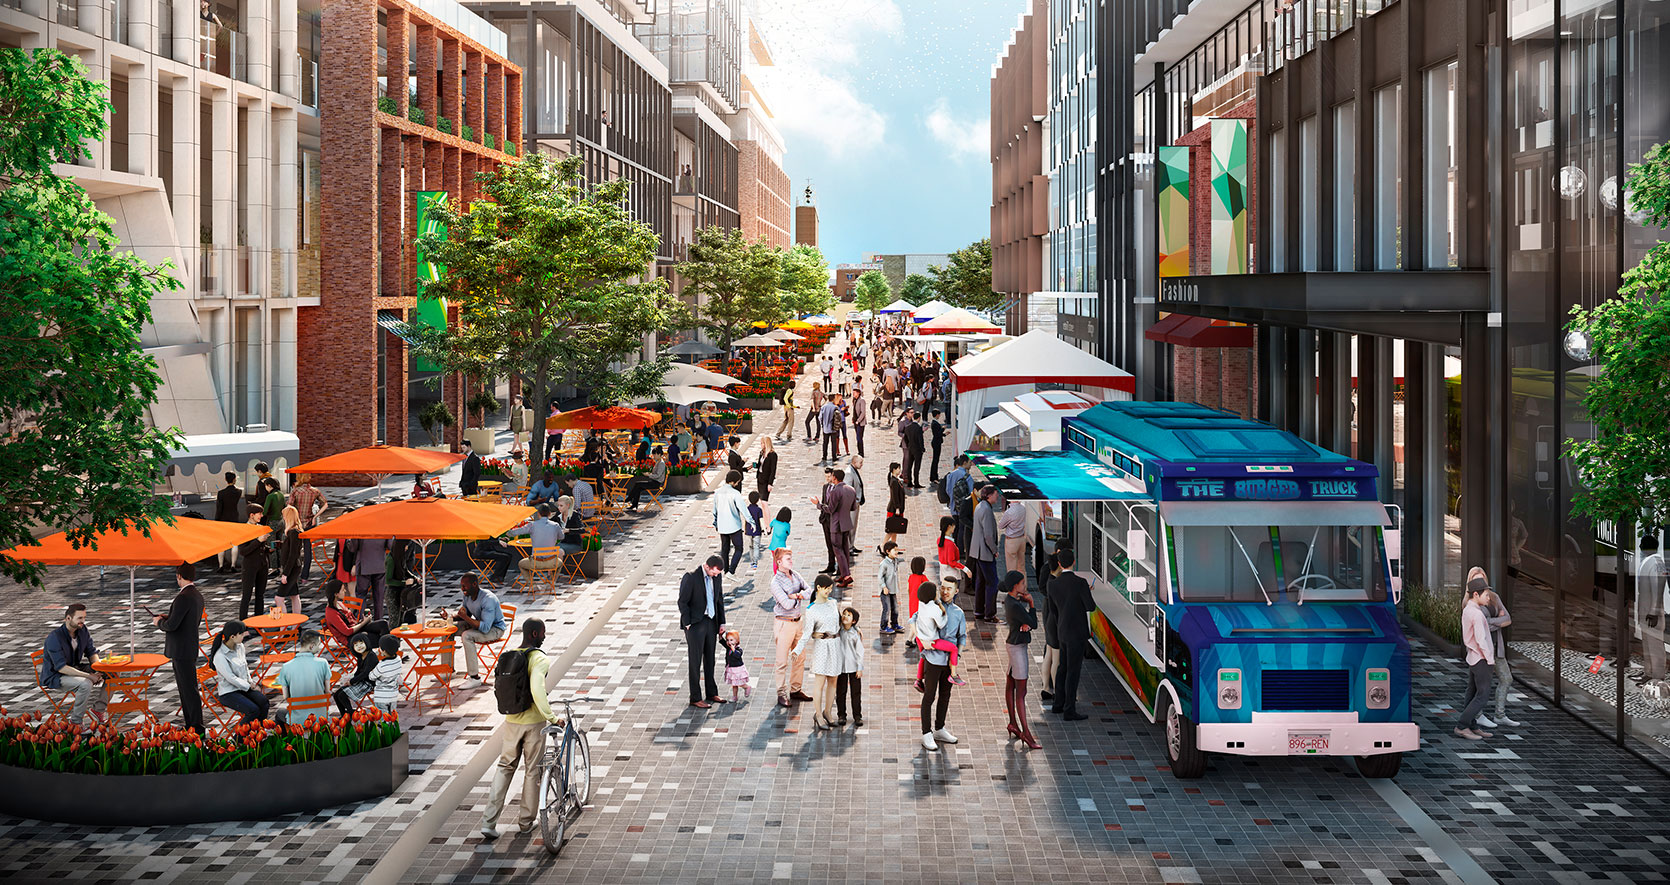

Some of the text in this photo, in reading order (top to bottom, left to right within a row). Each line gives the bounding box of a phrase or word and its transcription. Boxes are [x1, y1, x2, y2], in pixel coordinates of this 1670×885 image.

[1163, 279, 1199, 302] Fashion
[1176, 479, 1358, 500] THE BURGER TRUCK
